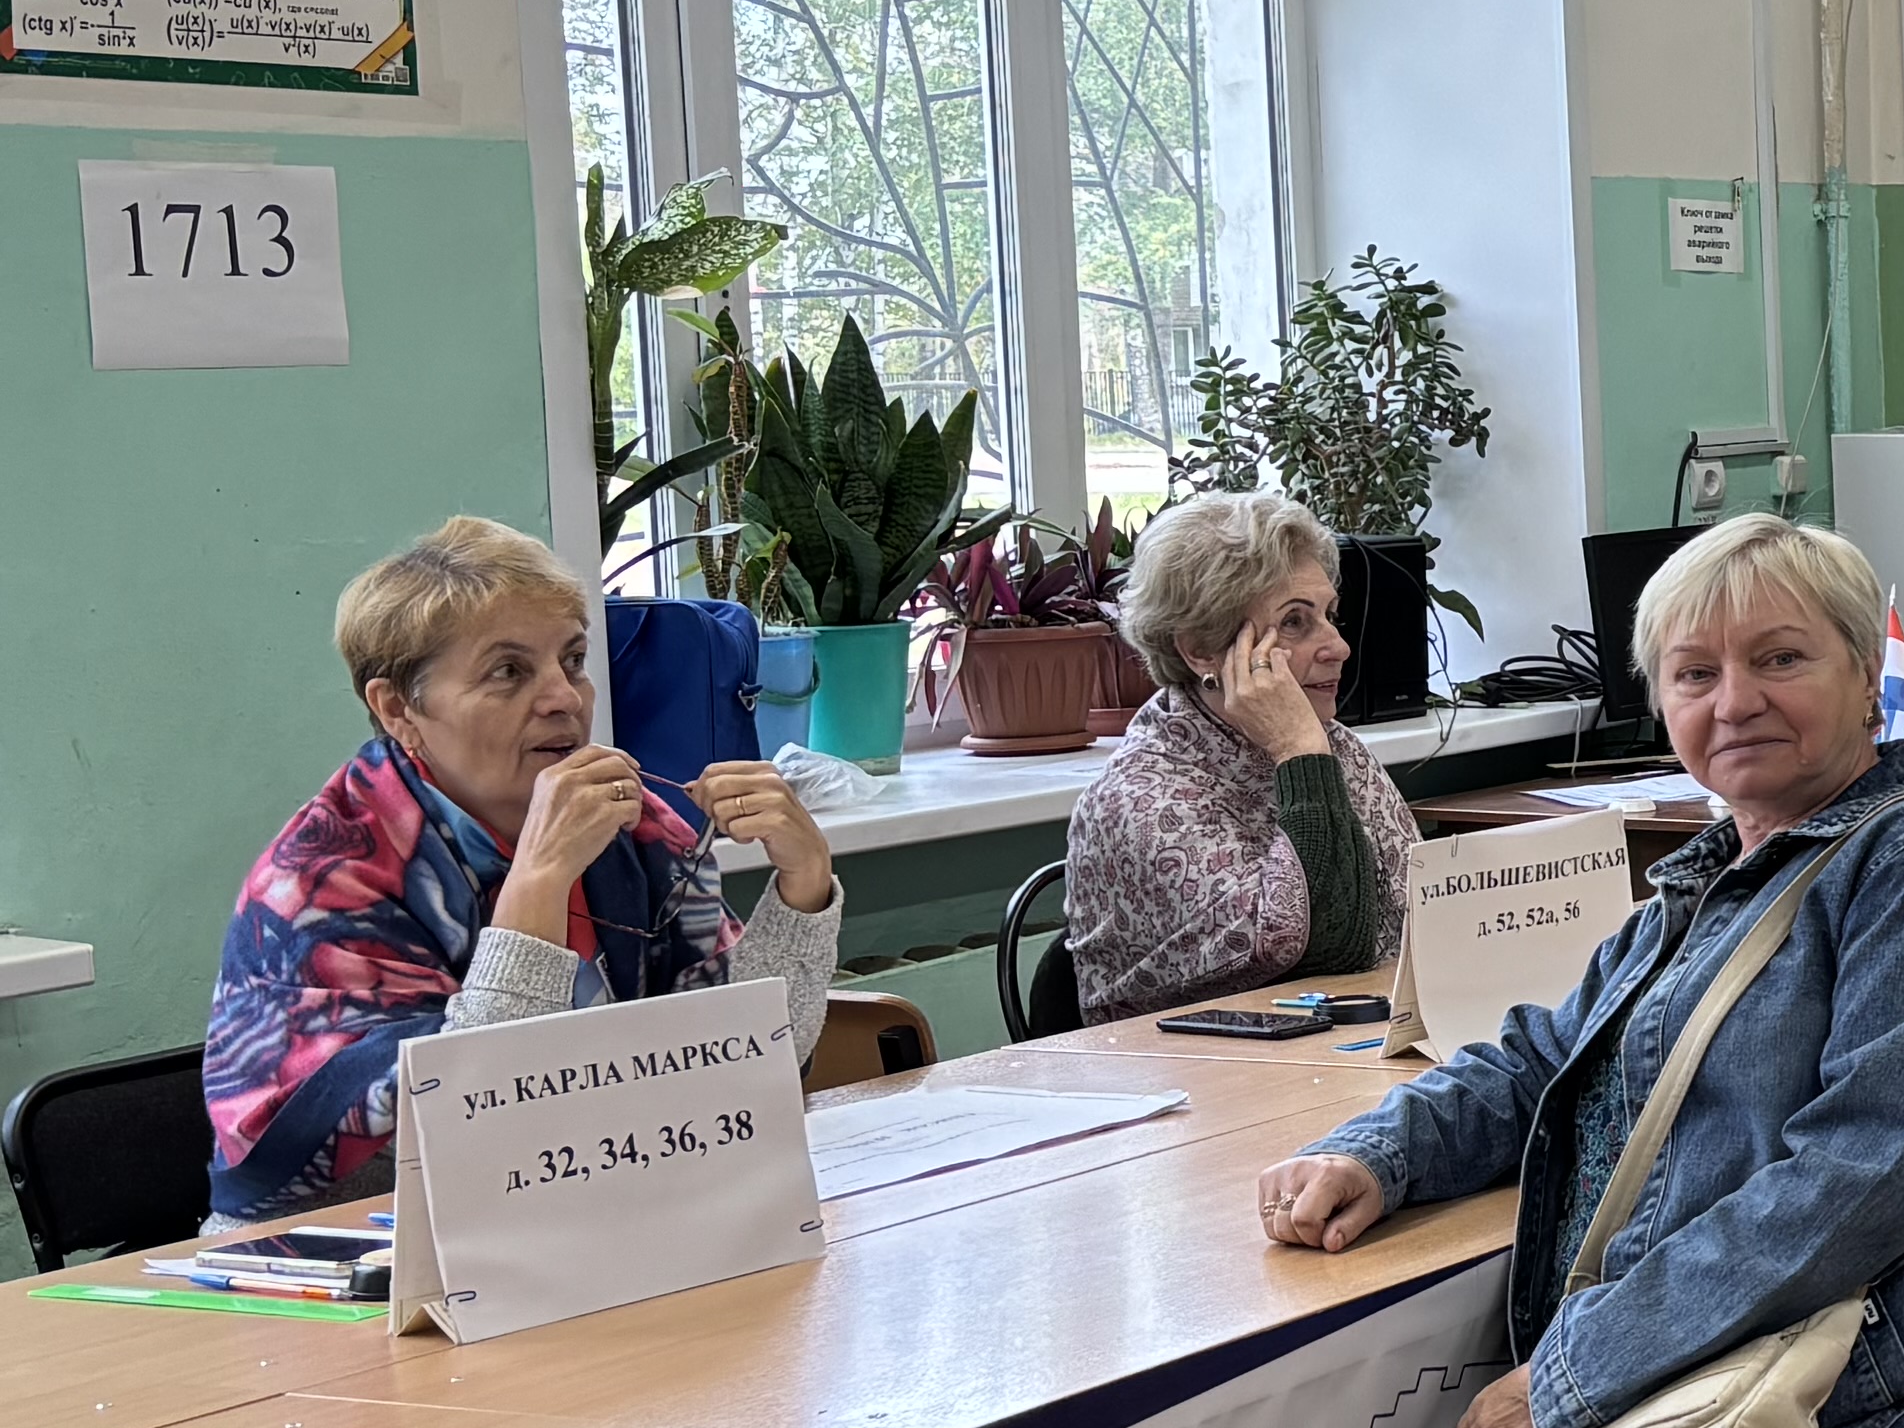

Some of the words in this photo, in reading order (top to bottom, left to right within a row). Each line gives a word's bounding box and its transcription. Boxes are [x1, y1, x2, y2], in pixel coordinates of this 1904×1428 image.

[121, 202, 294, 278] 1713
[1477, 922, 1491, 938] д.
[1497, 912, 1520, 933] 52,
[1526, 907, 1559, 928] 52а,
[1564, 900, 1580, 920] 56
[464, 1091, 506, 1119] ул.
[514, 1059, 624, 1102] КАРЛА
[632, 1035, 764, 1081] МАРКСА
[506, 1167, 531, 1193] д.
[538, 1146, 591, 1182] 32,
[599, 1133, 650, 1171] 34,
[658, 1120, 707, 1157] 36,
[716, 1109, 755, 1145] 38
